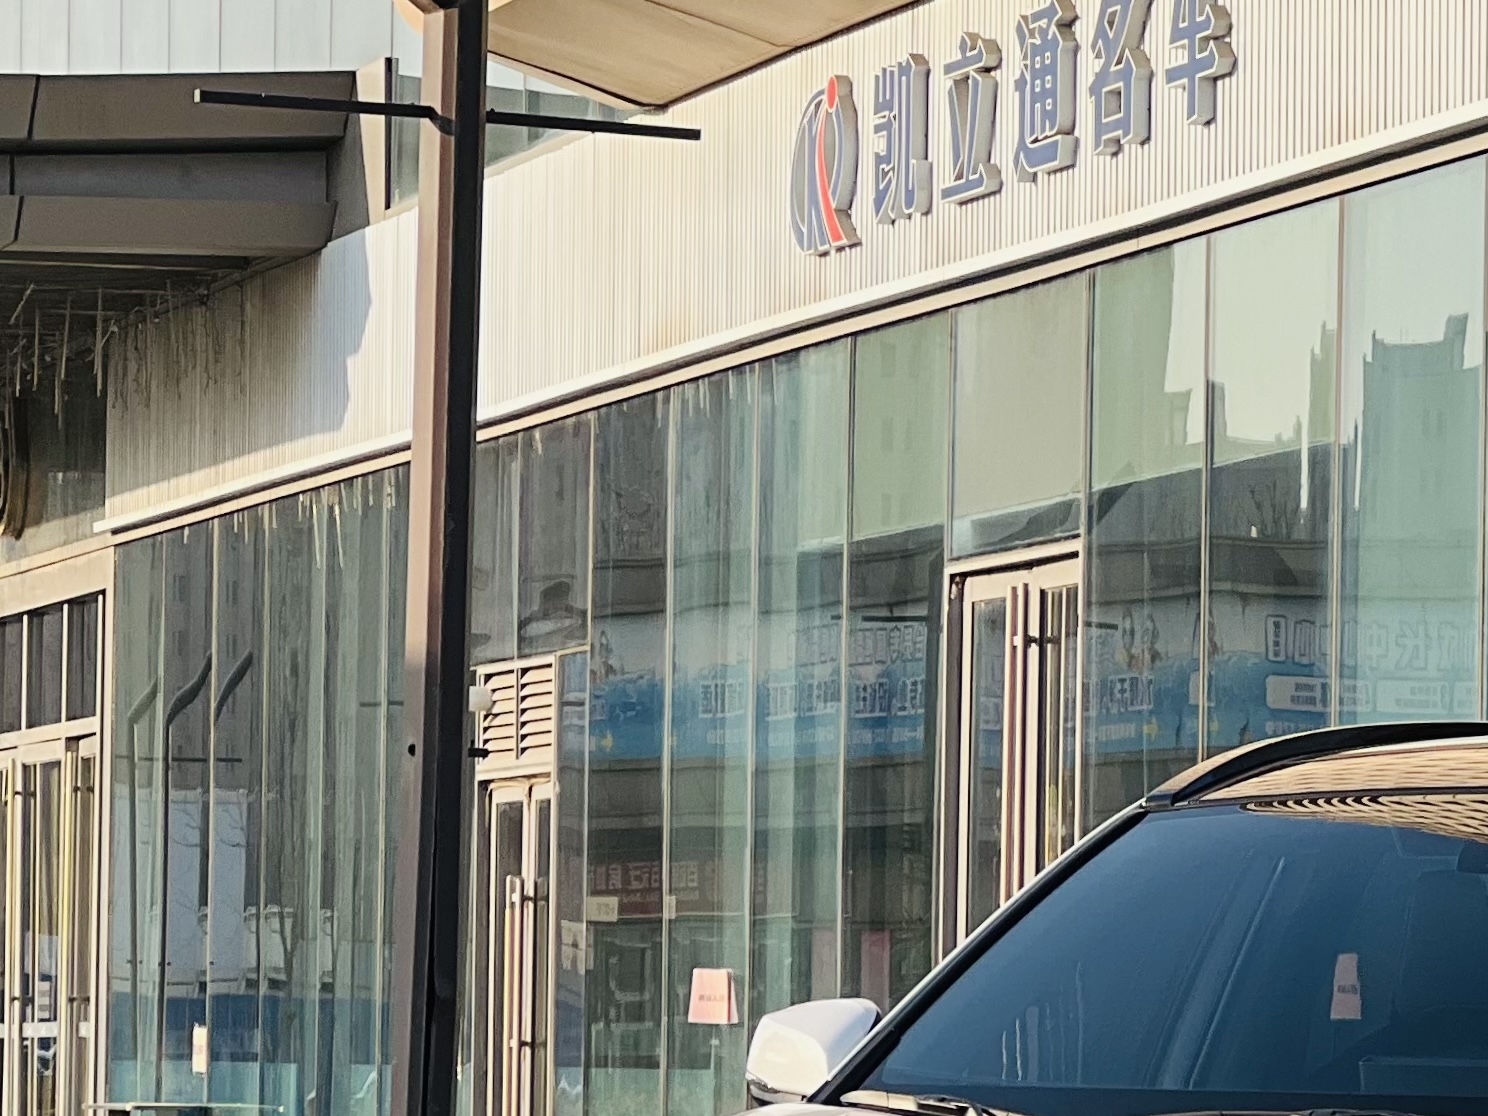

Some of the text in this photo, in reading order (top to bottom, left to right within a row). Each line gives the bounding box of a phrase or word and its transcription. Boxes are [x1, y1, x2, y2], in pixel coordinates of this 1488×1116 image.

[872, 0, 1234, 223] 凯立通名车
